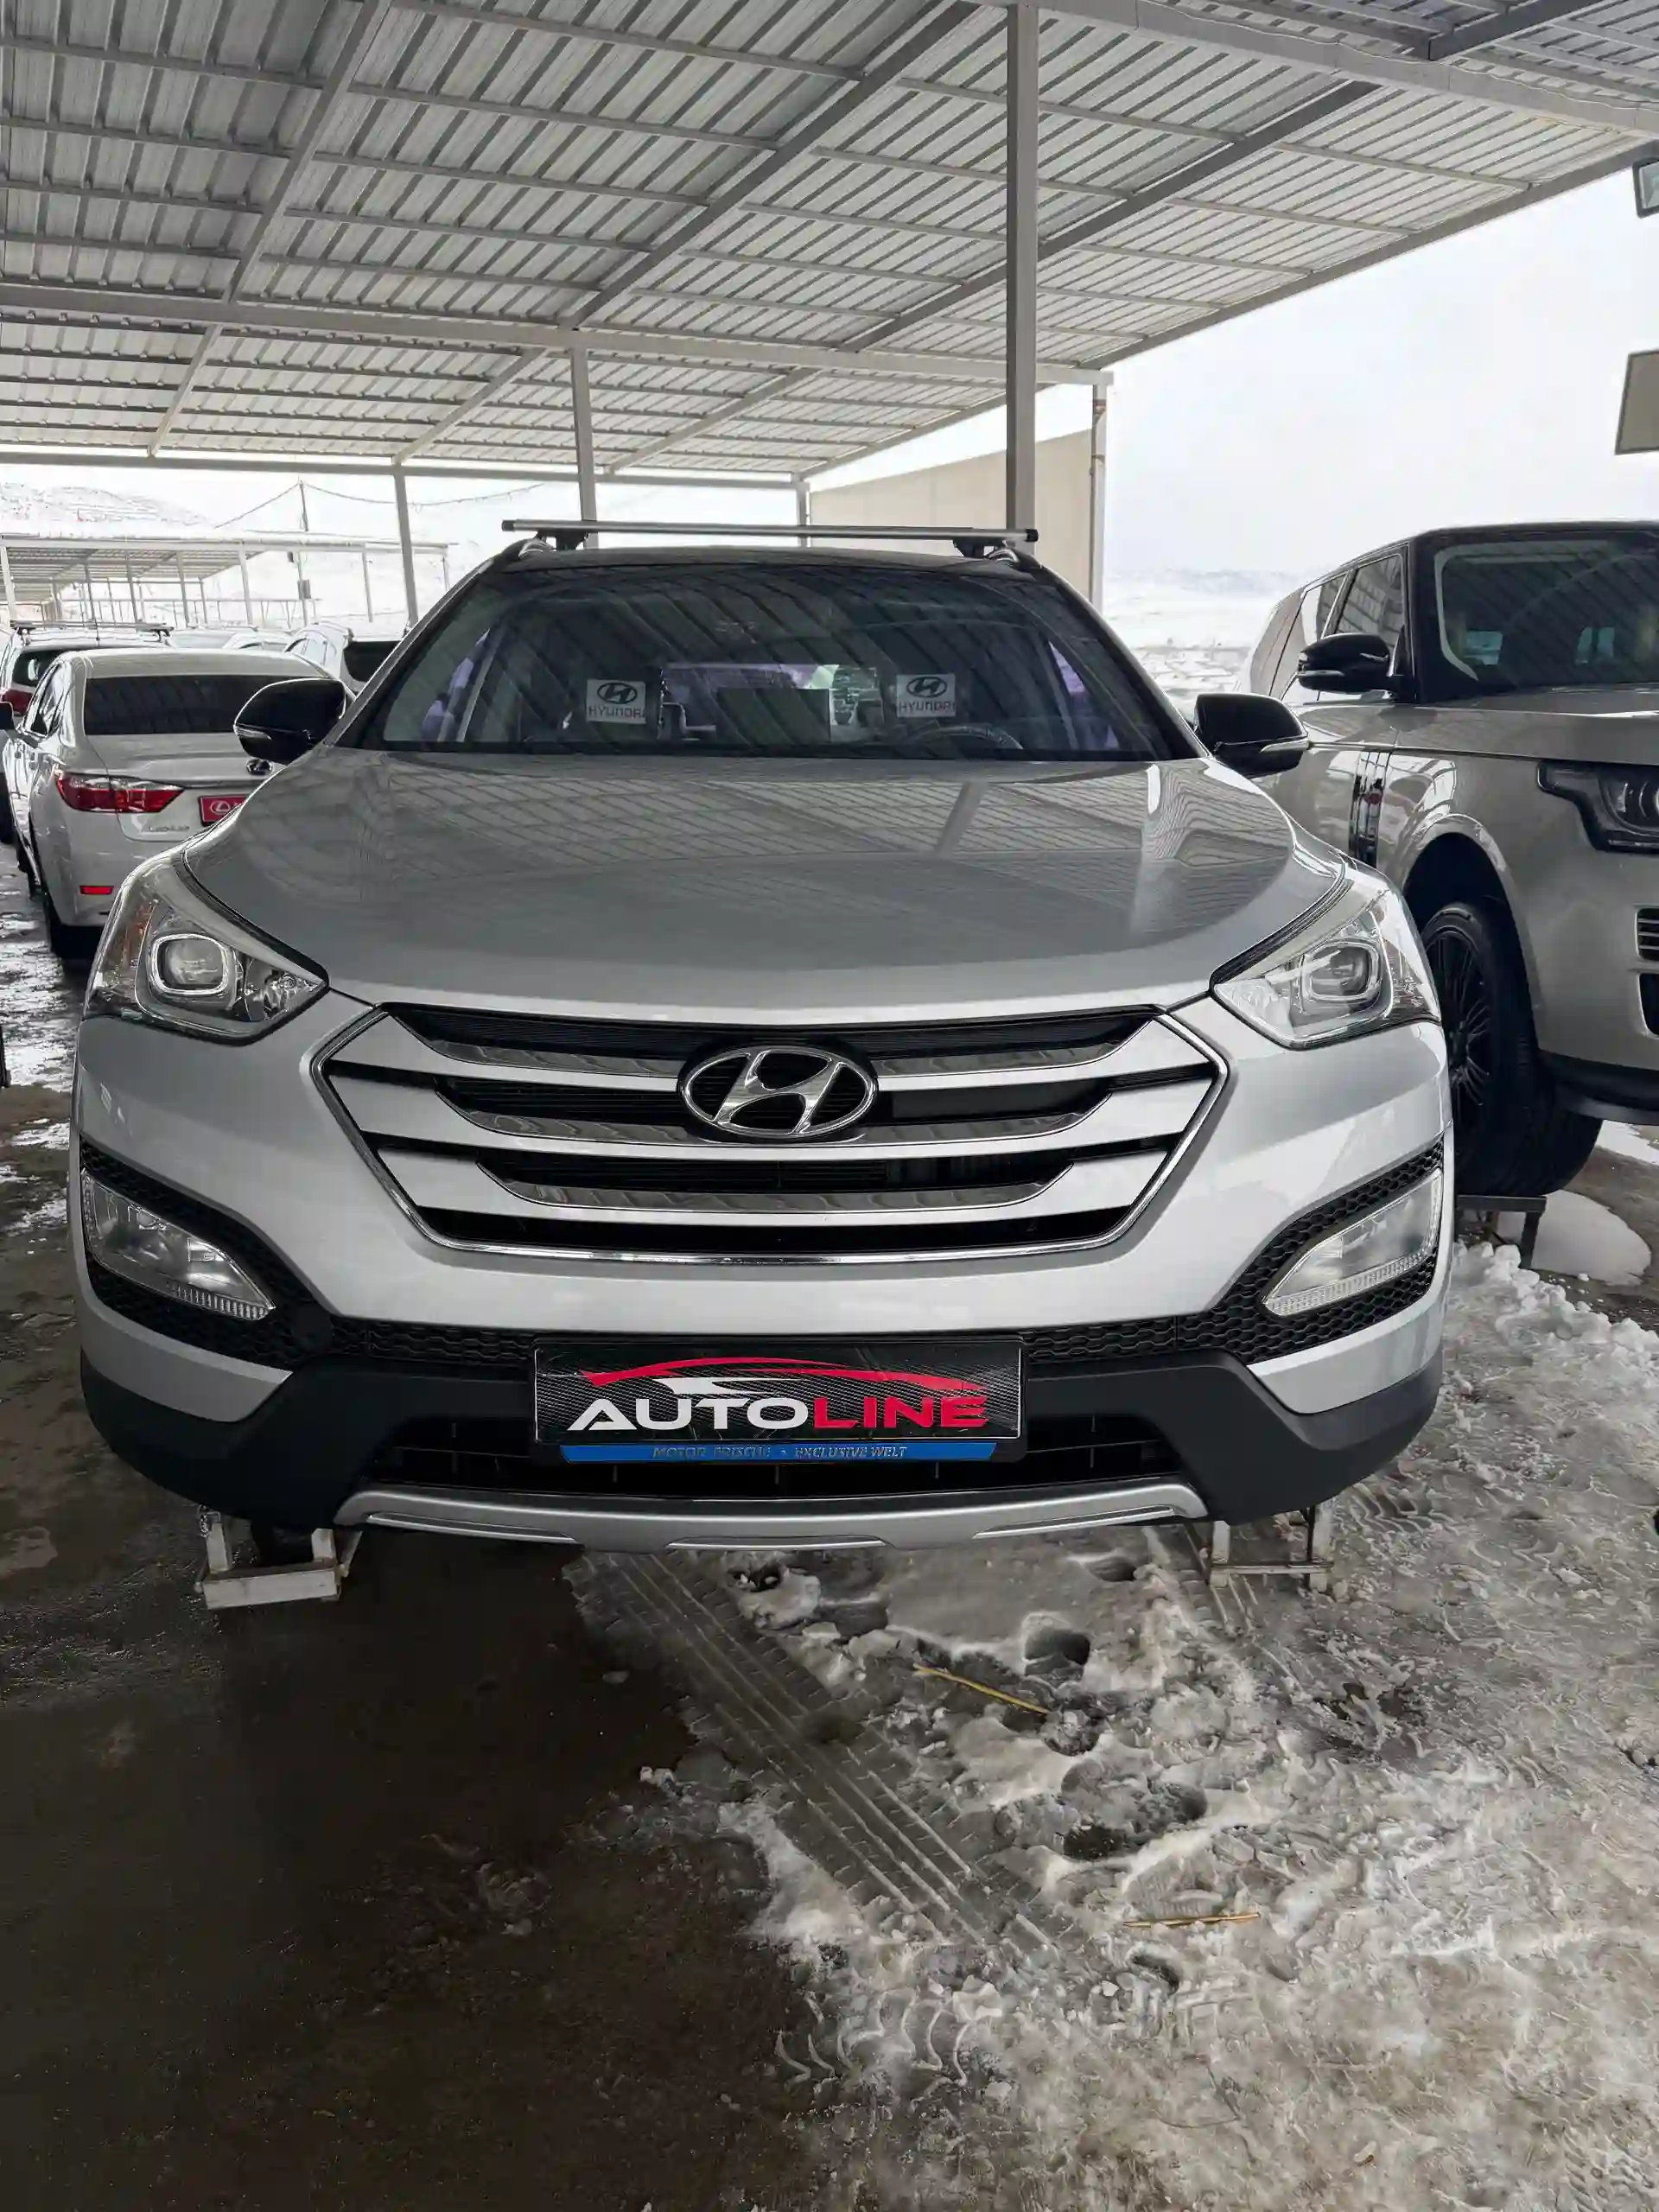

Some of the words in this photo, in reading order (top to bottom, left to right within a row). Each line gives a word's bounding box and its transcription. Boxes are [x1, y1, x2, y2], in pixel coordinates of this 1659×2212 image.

[567, 1395, 990, 1431] AUTOLINE
[794, 1446, 868, 1459] EXCLUSIVE
[871, 1446, 907, 1459] WELT
